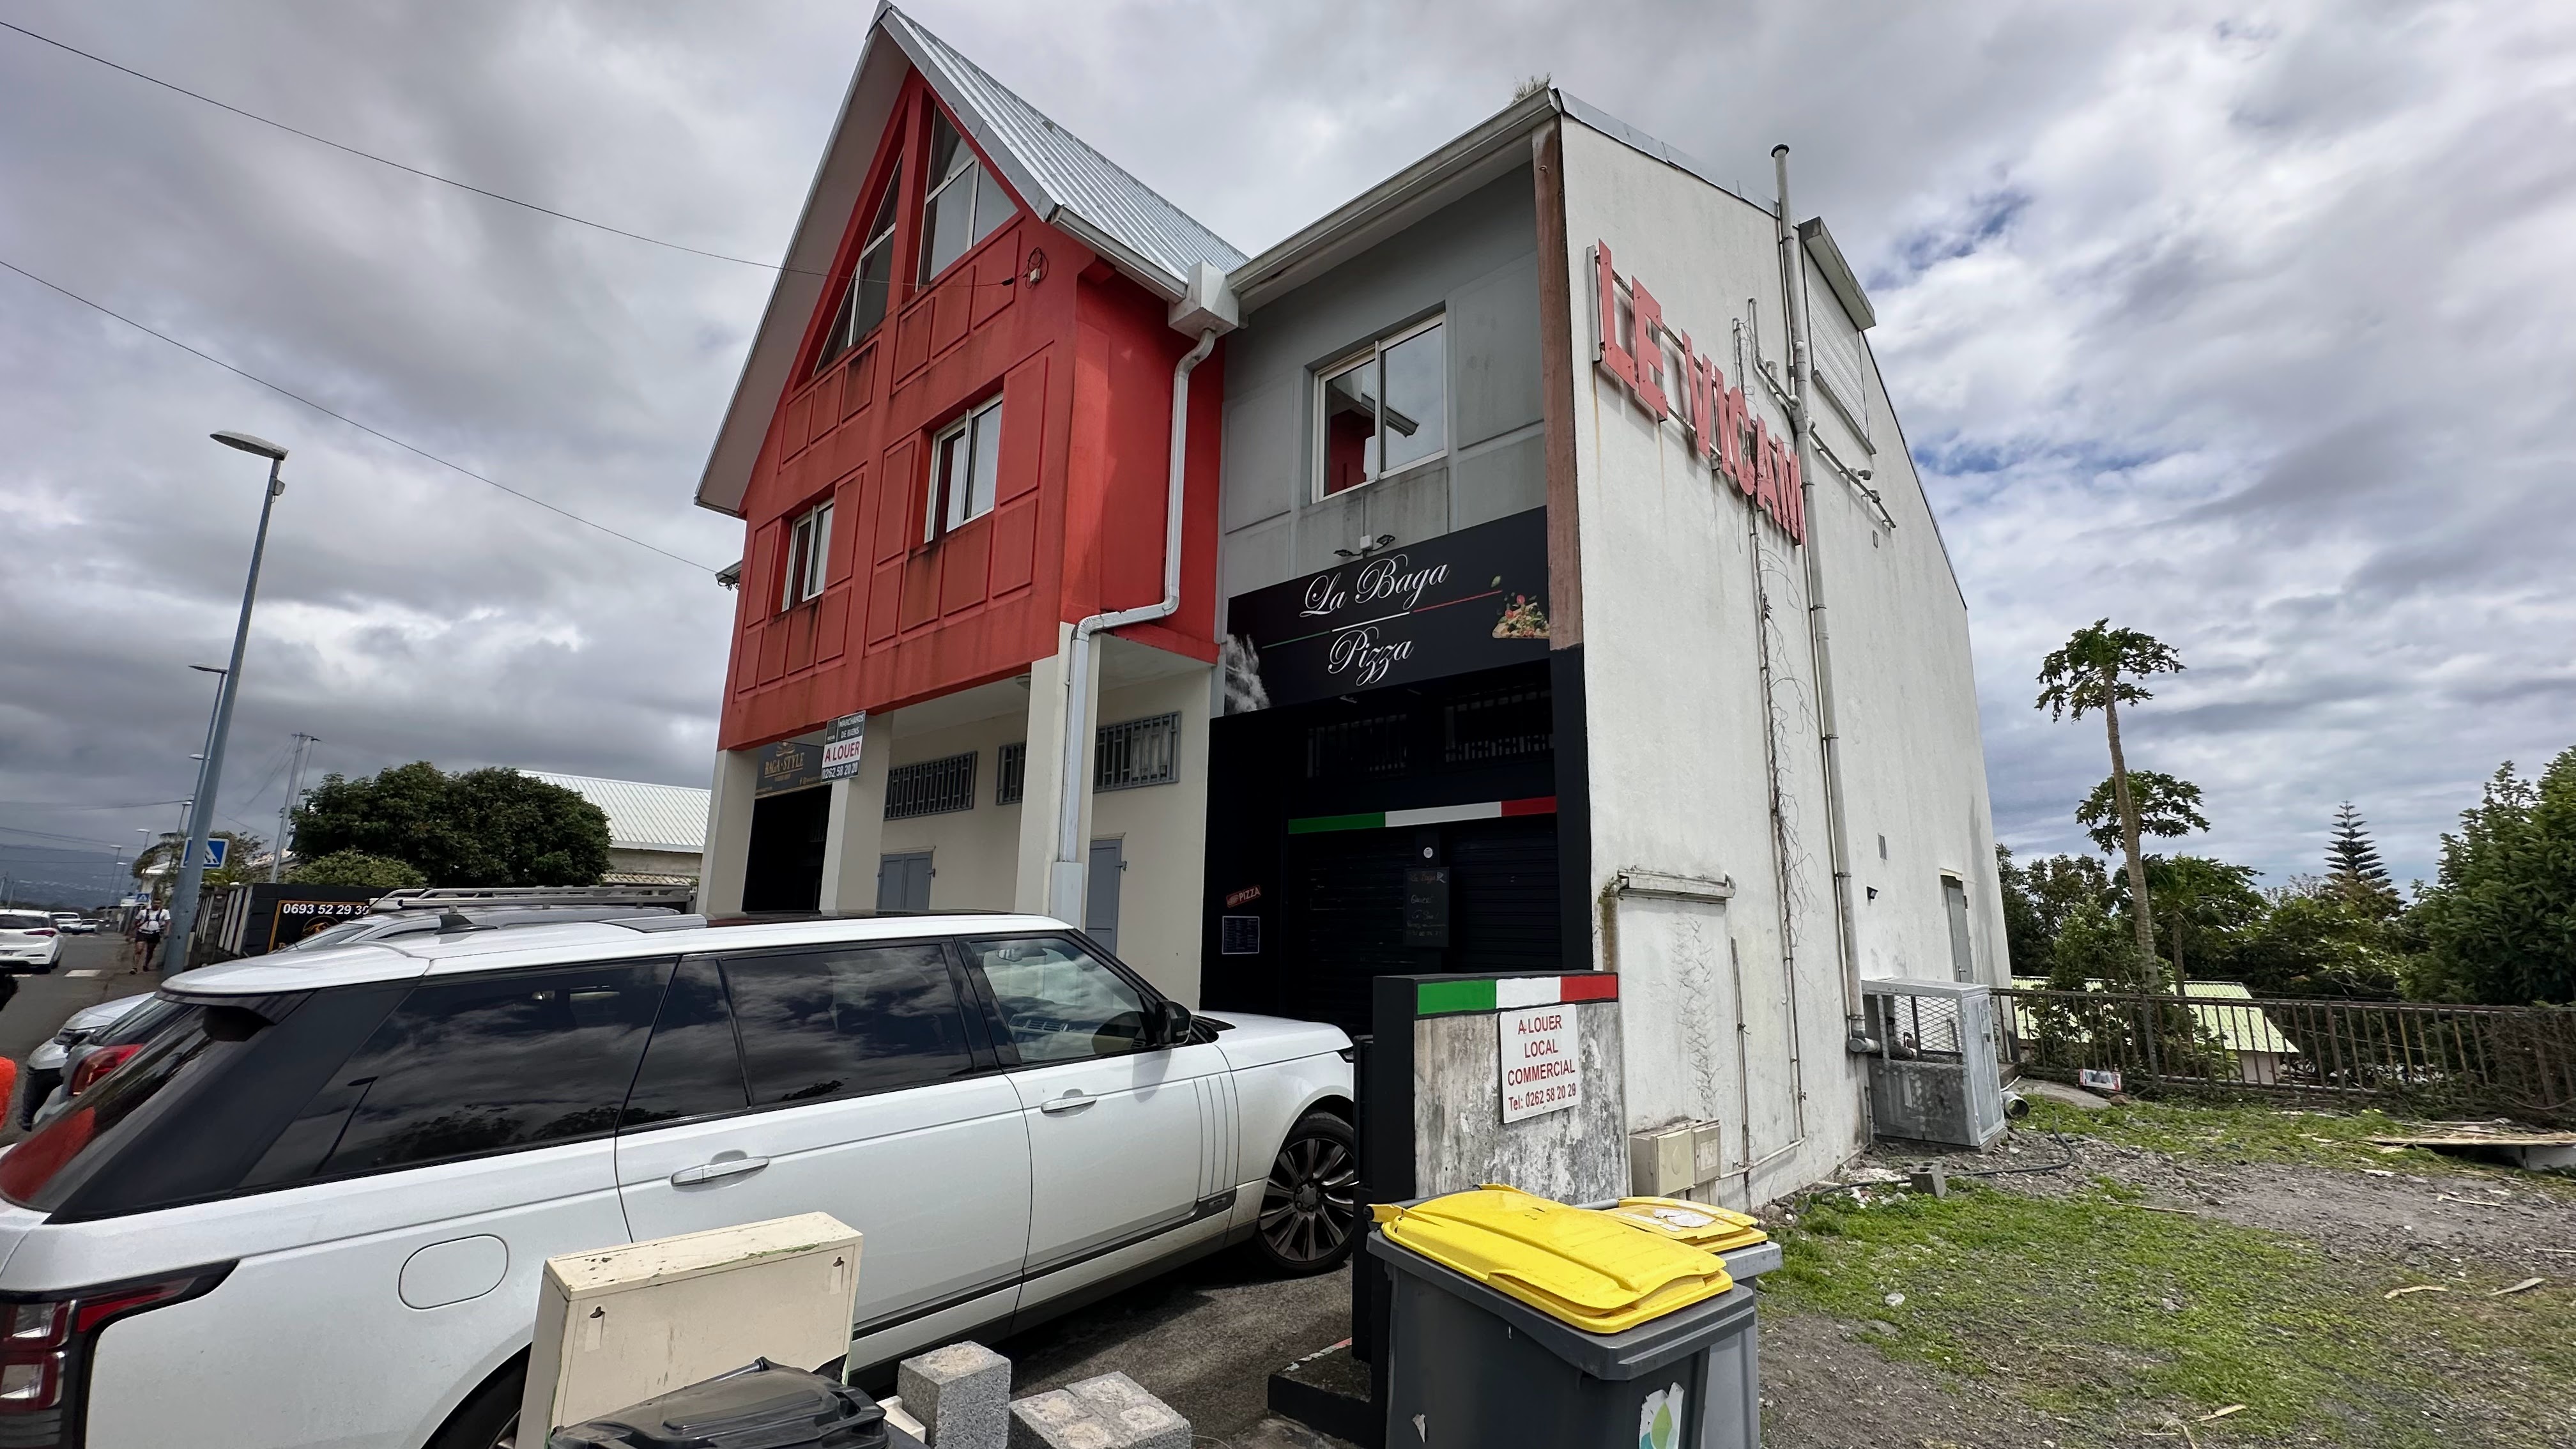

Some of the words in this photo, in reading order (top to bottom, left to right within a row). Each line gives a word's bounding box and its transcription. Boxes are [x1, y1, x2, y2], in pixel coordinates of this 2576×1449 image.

[1598, 238, 1667, 420] LE
[1681, 328, 1807, 545] VICAM
[1299, 572, 1348, 618] La
[1354, 554, 1450, 611] Baga
[1328, 626, 1415, 686] Pizza
[824, 747, 831, 762] A
[832, 740, 860, 761] LOUER
[822, 767, 836, 779] 0262
[836, 765, 843, 777] 58
[1239, 887, 1261, 902] PIZZA
[283, 903, 314, 914] 0693
[318, 904, 334, 914] 52
[335, 905, 351, 915] 29
[1518, 1019, 1526, 1034] A
[1528, 1015, 1562, 1033] LOUER
[1524, 1039, 1558, 1058] LOCAL
[1508, 1059, 1575, 1086] COMMERCIAL
[1508, 1095, 1523, 1111] Tel:
[1526, 1090, 1544, 1107] 0262
[1546, 1087, 1555, 1103] 58
[1557, 1085, 1565, 1100] 20
